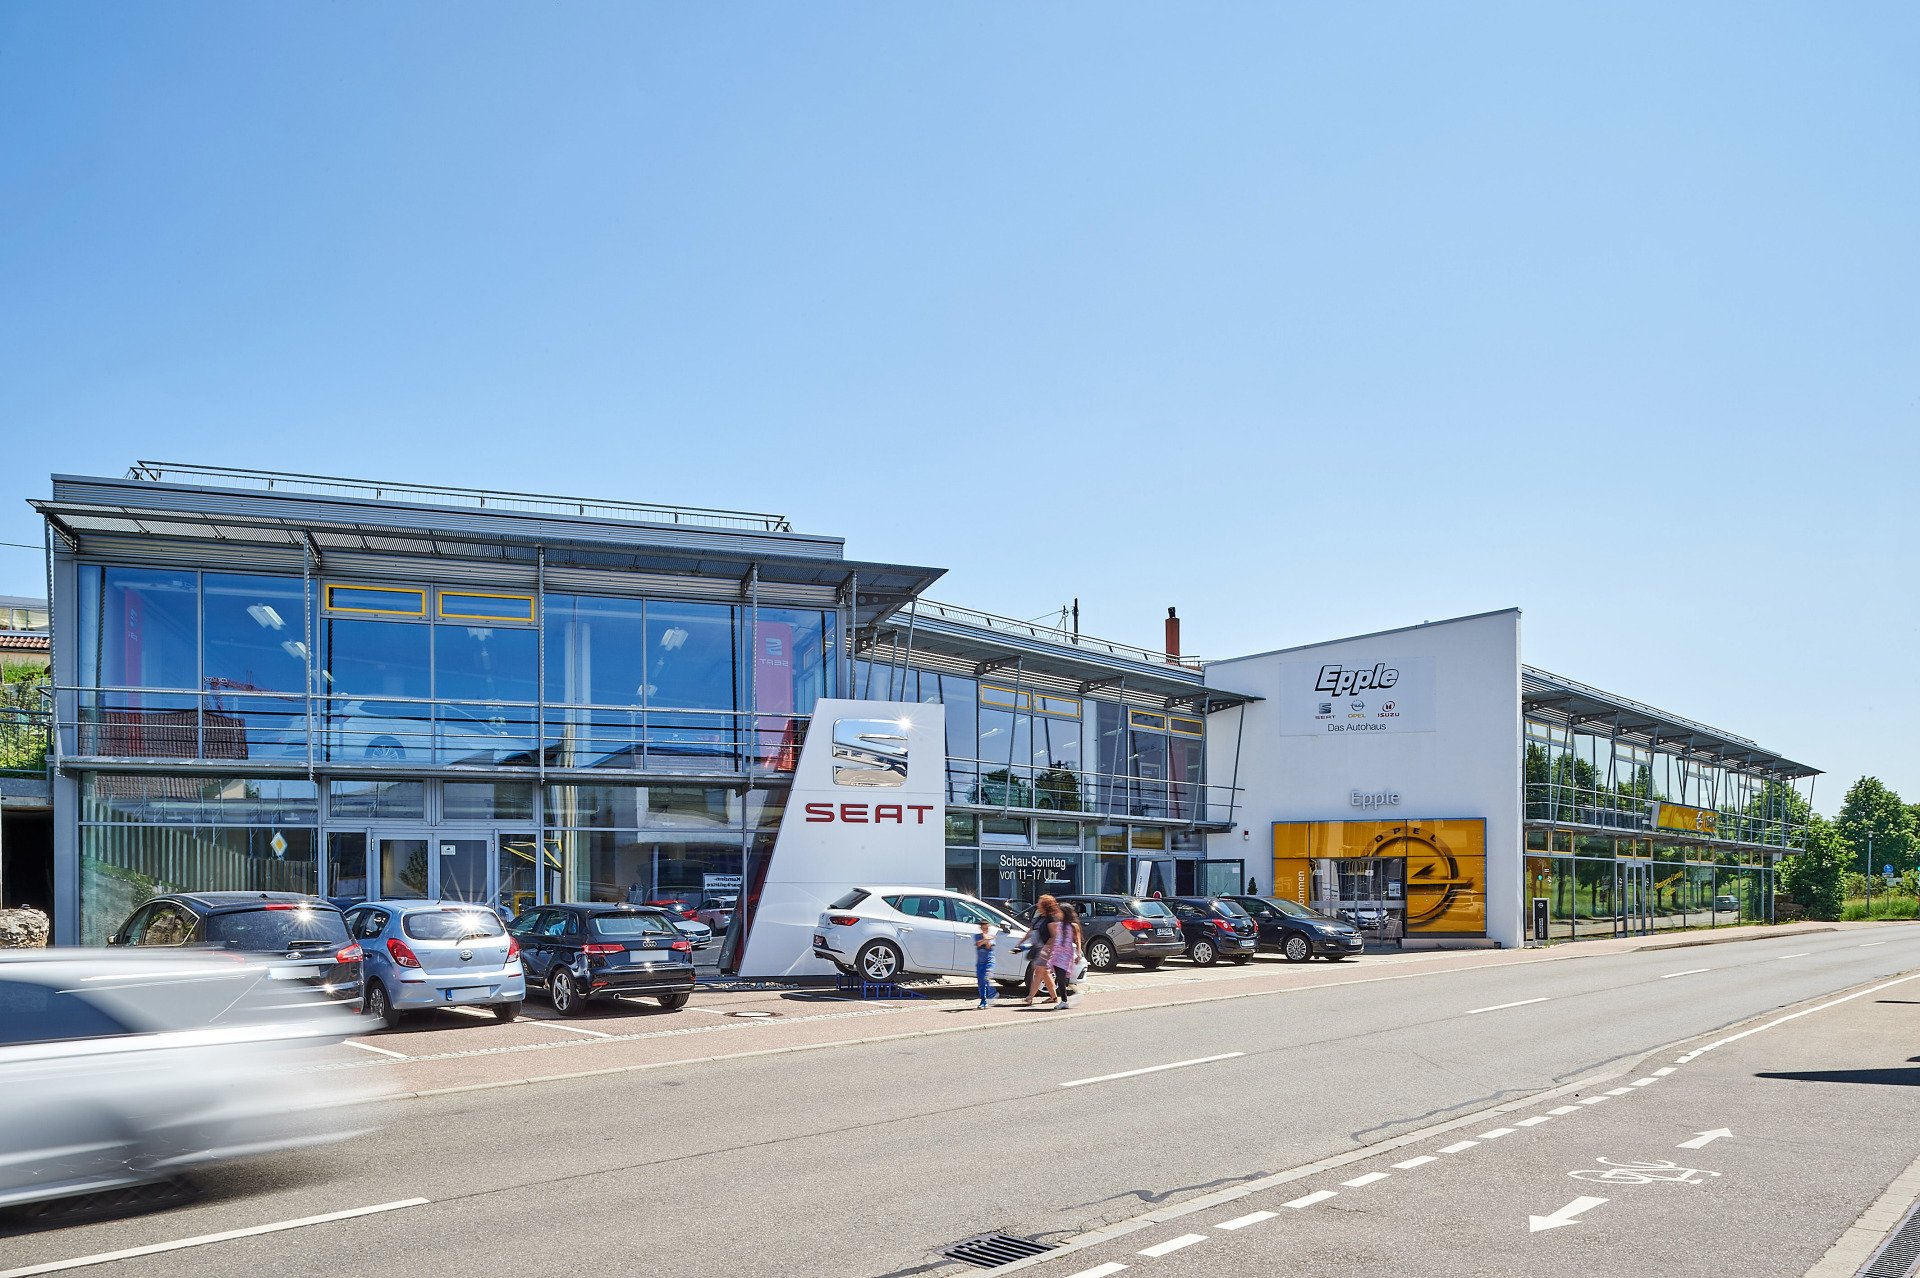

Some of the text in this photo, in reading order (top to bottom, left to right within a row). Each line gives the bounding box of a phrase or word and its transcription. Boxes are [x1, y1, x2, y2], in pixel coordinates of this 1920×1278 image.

[1314, 662, 1400, 697] Epple
[1327, 722, 1387, 732] Das Autohaus
[1351, 790, 1400, 810] Epple
[805, 803, 934, 824] SEAT
[1375, 827, 1437, 843] OPEL
[1000, 854, 1066, 870] Schau-Sonntag
[1000, 870, 1016, 880] von
[1043, 869, 1059, 880] Uhr
[1297, 870, 1306, 905] ommen
